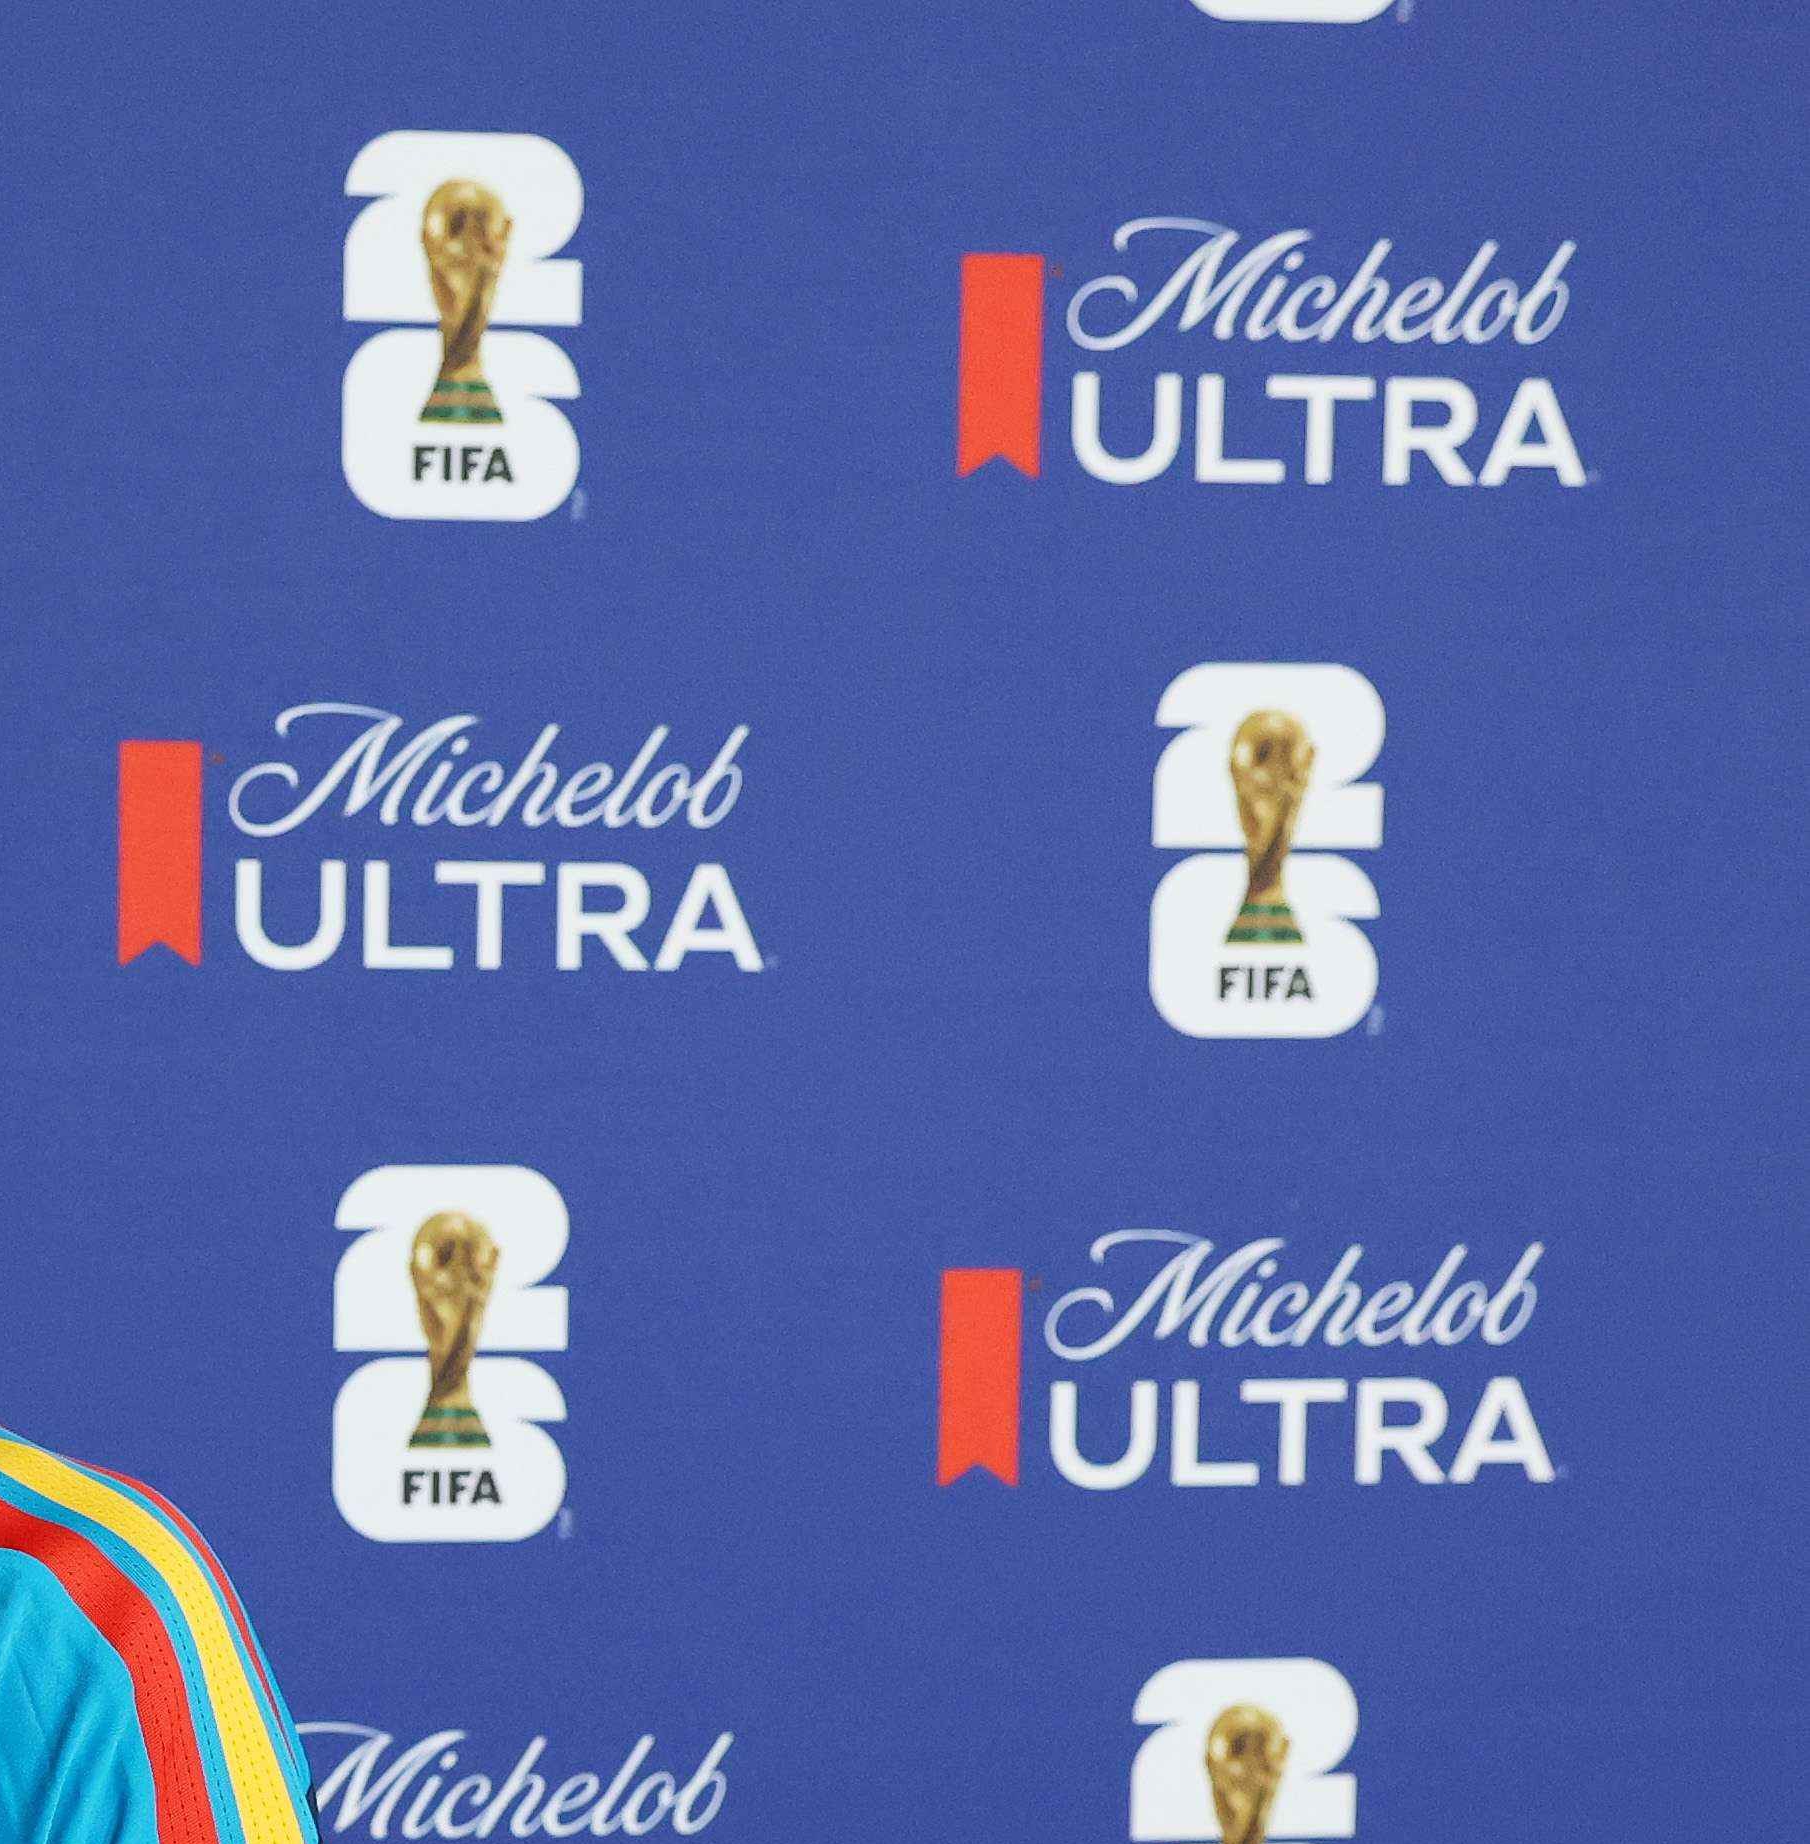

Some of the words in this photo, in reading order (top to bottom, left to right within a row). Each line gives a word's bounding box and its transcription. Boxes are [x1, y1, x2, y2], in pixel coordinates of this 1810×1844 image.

[1067, 217, 1576, 350] Michelob
[413, 445, 514, 483] FIFA
[1072, 372, 1586, 487] ULTRA
[229, 703, 749, 836] Michelob
[235, 859, 764, 972] ULTRA
[1218, 966, 1313, 1000] FIFA
[1045, 1230, 1543, 1360] Michelob
[401, 1470, 502, 1505] FIFA
[1050, 1377, 1555, 1490] ULTRA
